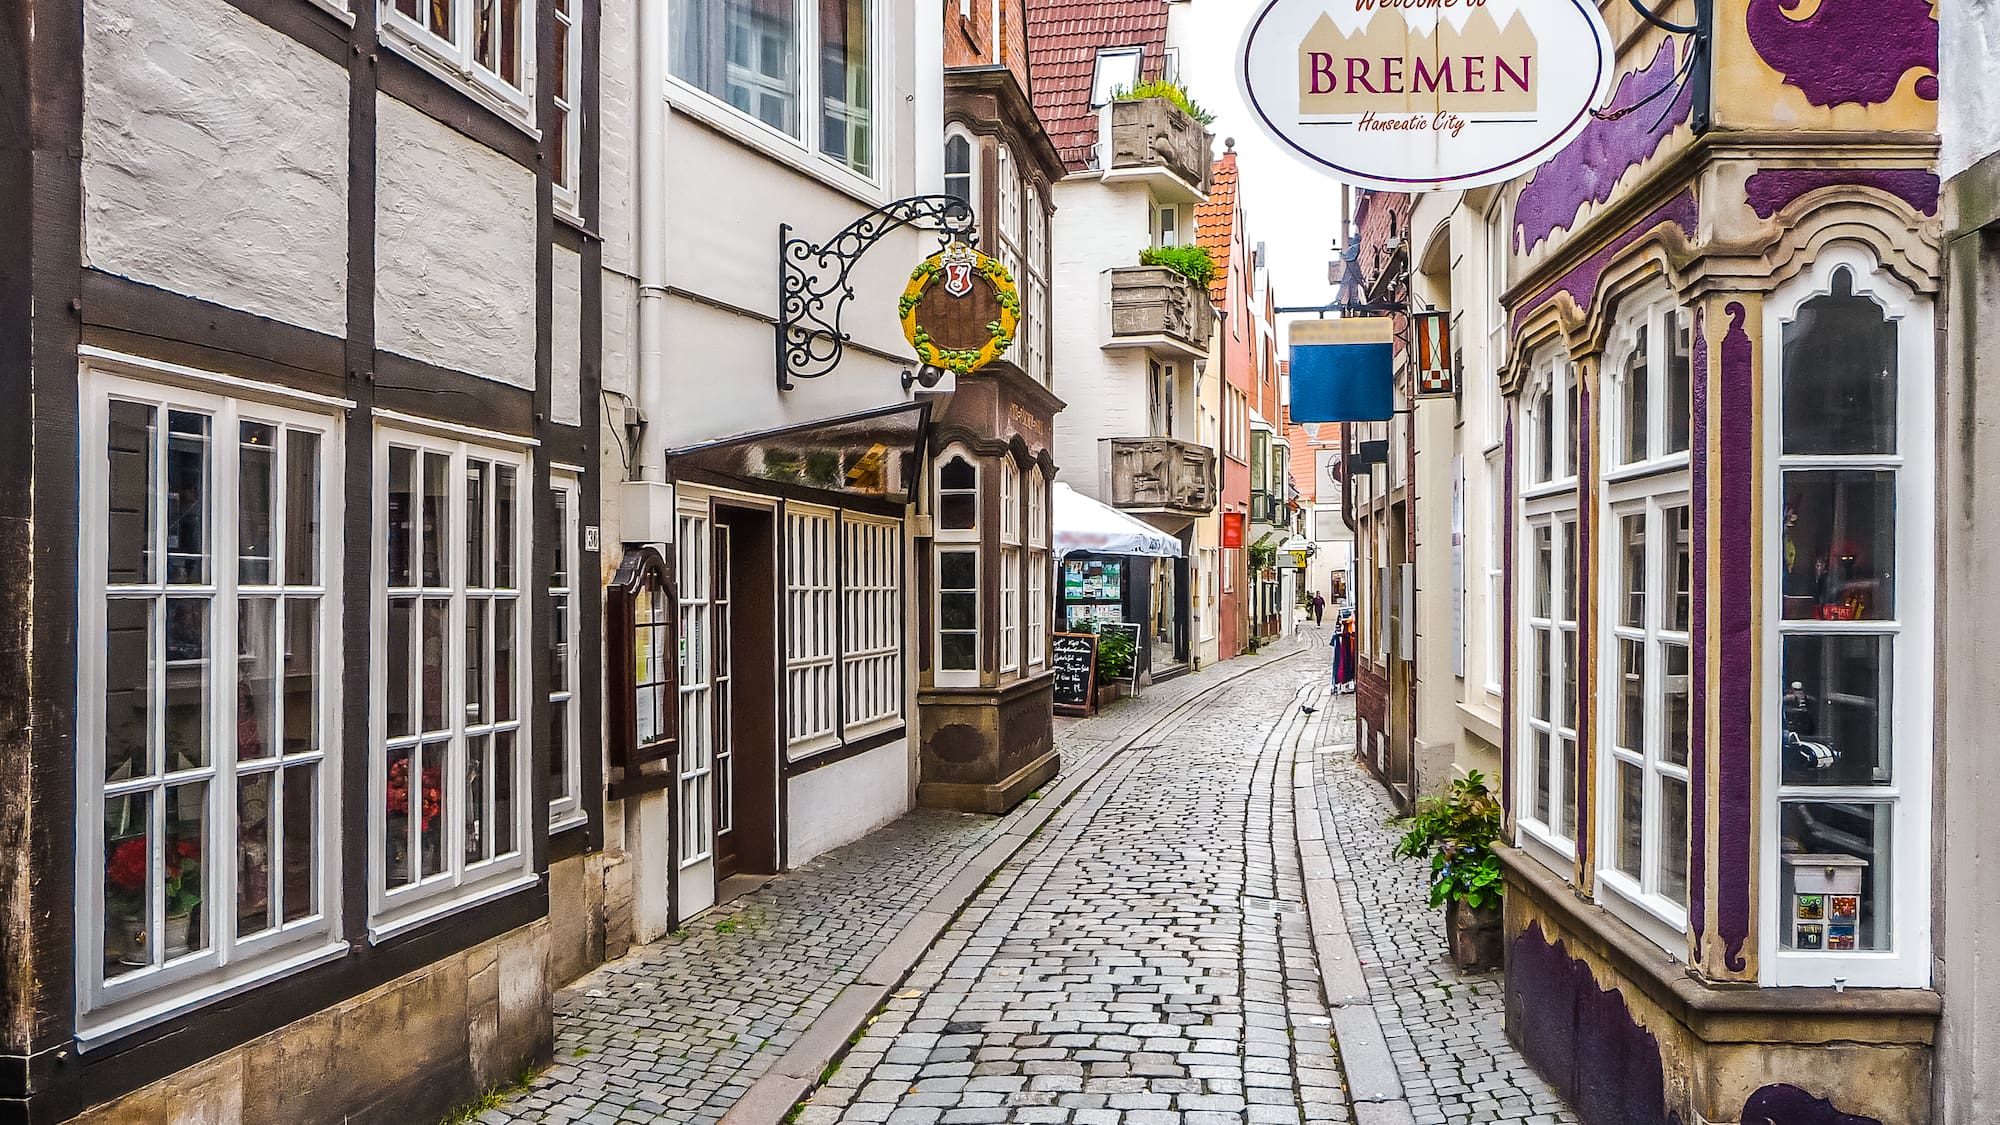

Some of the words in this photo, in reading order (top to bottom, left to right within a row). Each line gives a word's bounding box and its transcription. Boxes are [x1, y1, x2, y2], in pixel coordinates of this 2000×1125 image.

[1307, 52, 1532, 94] BREMEN
[1358, 110, 1427, 132] Hanseatic
[1432, 110, 1465, 137] City
